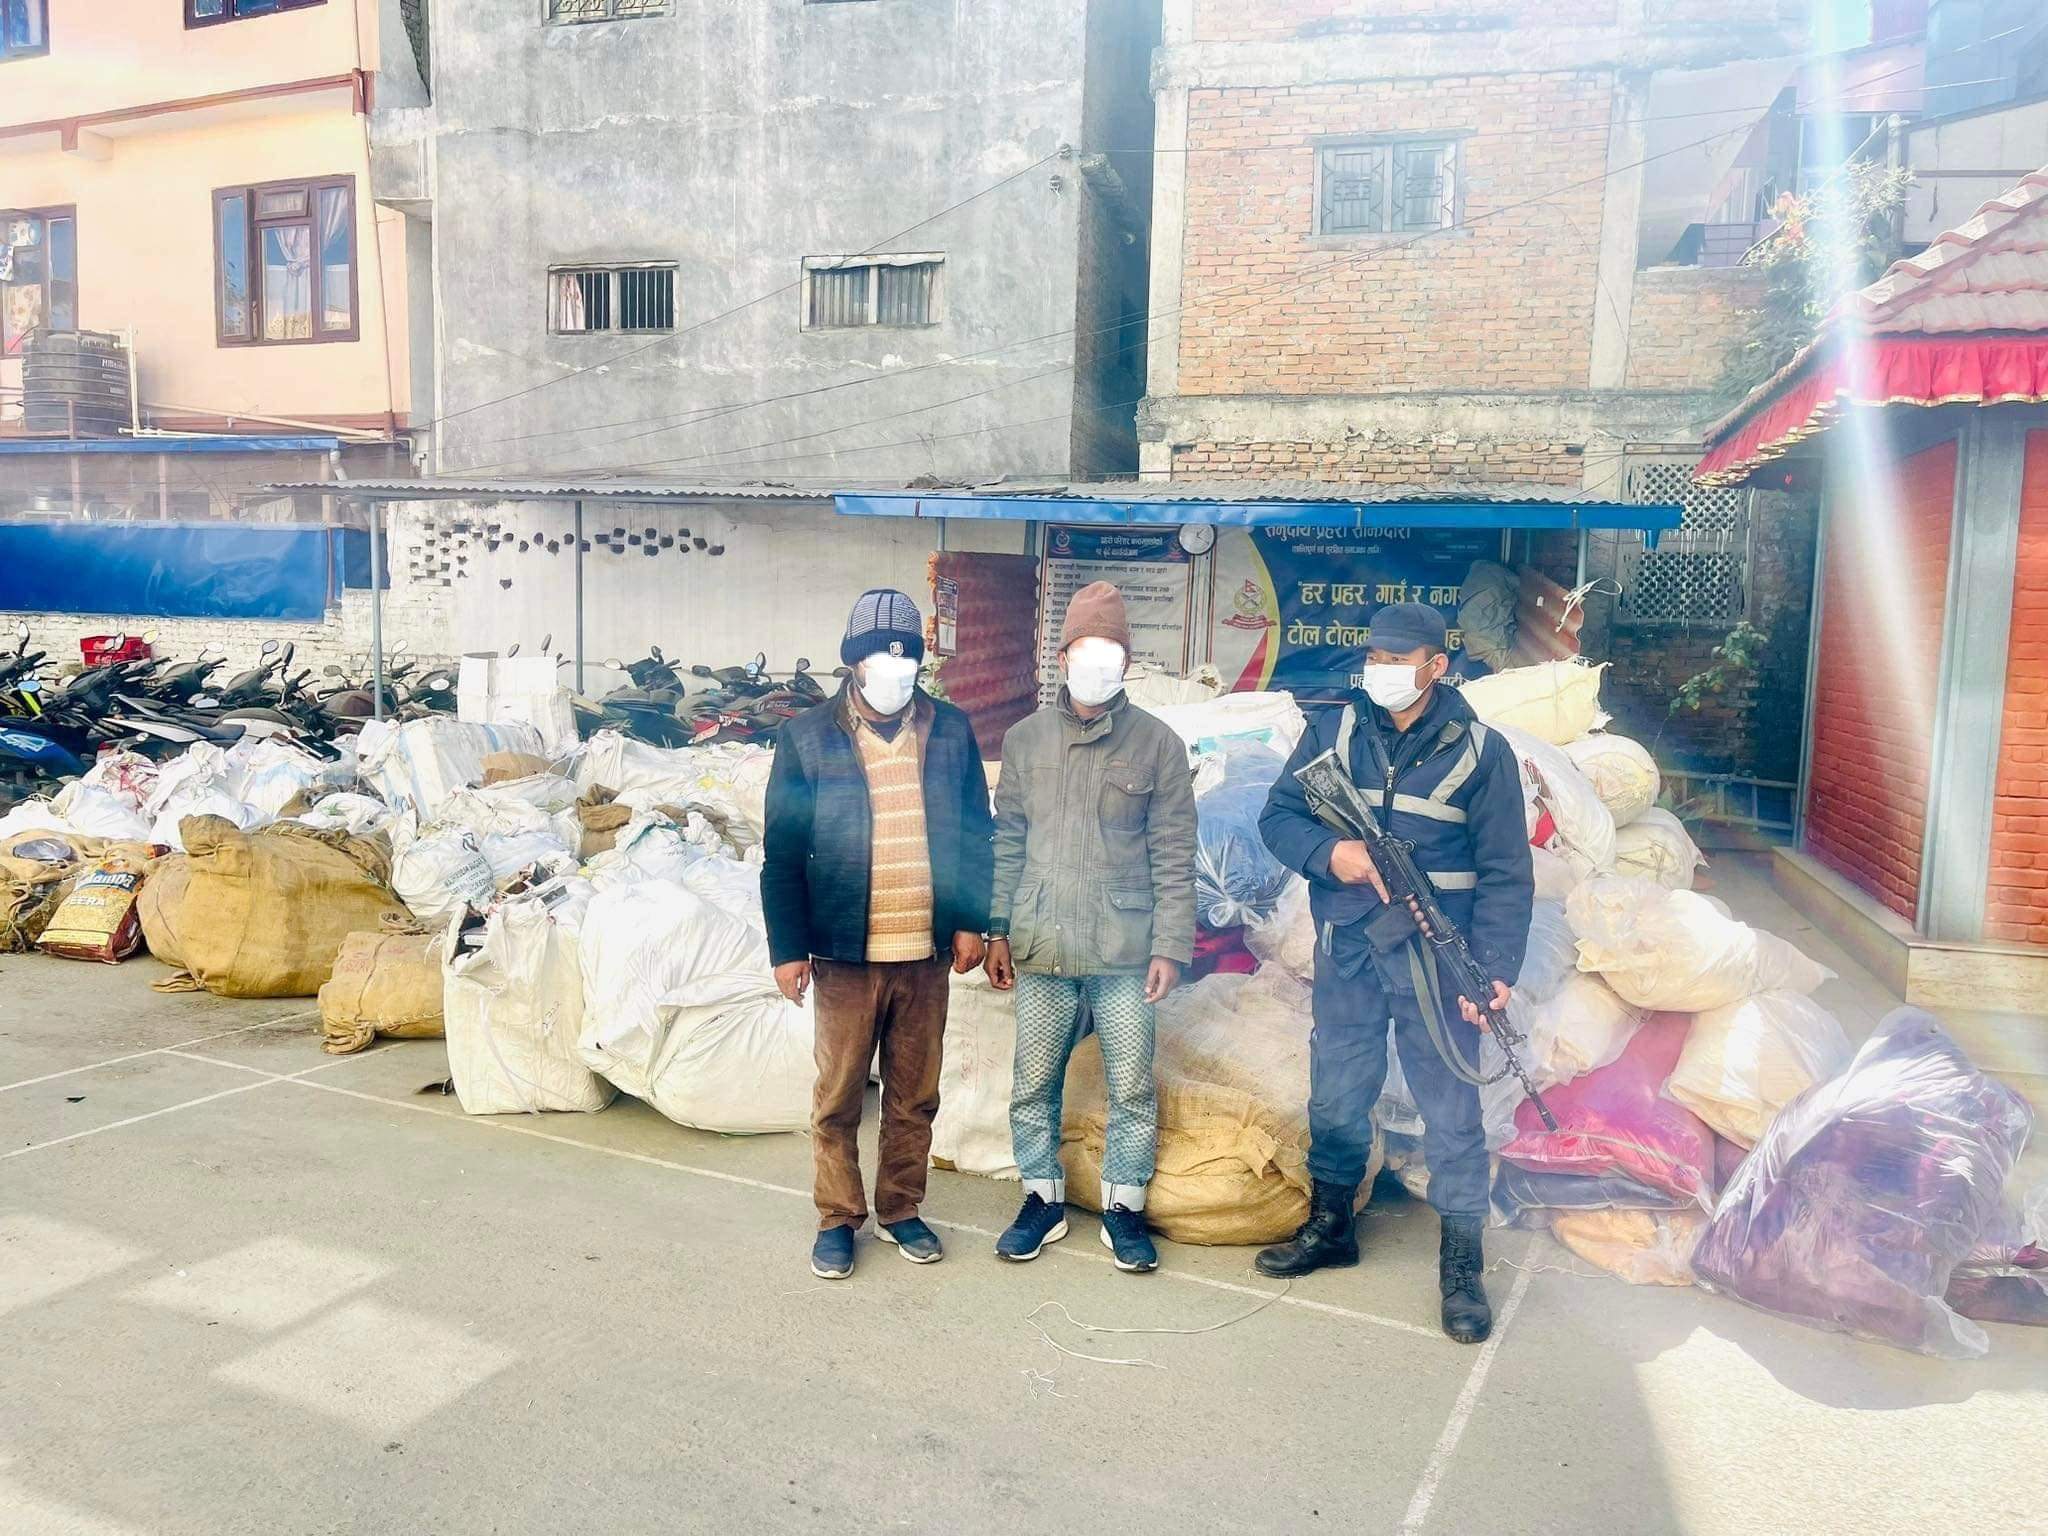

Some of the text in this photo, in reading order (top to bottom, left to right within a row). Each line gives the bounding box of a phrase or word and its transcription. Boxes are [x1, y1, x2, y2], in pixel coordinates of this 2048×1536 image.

[1412, 585, 1425, 605] र
[1430, 585, 1462, 606] नग
[1287, 619, 1321, 647] टोल
